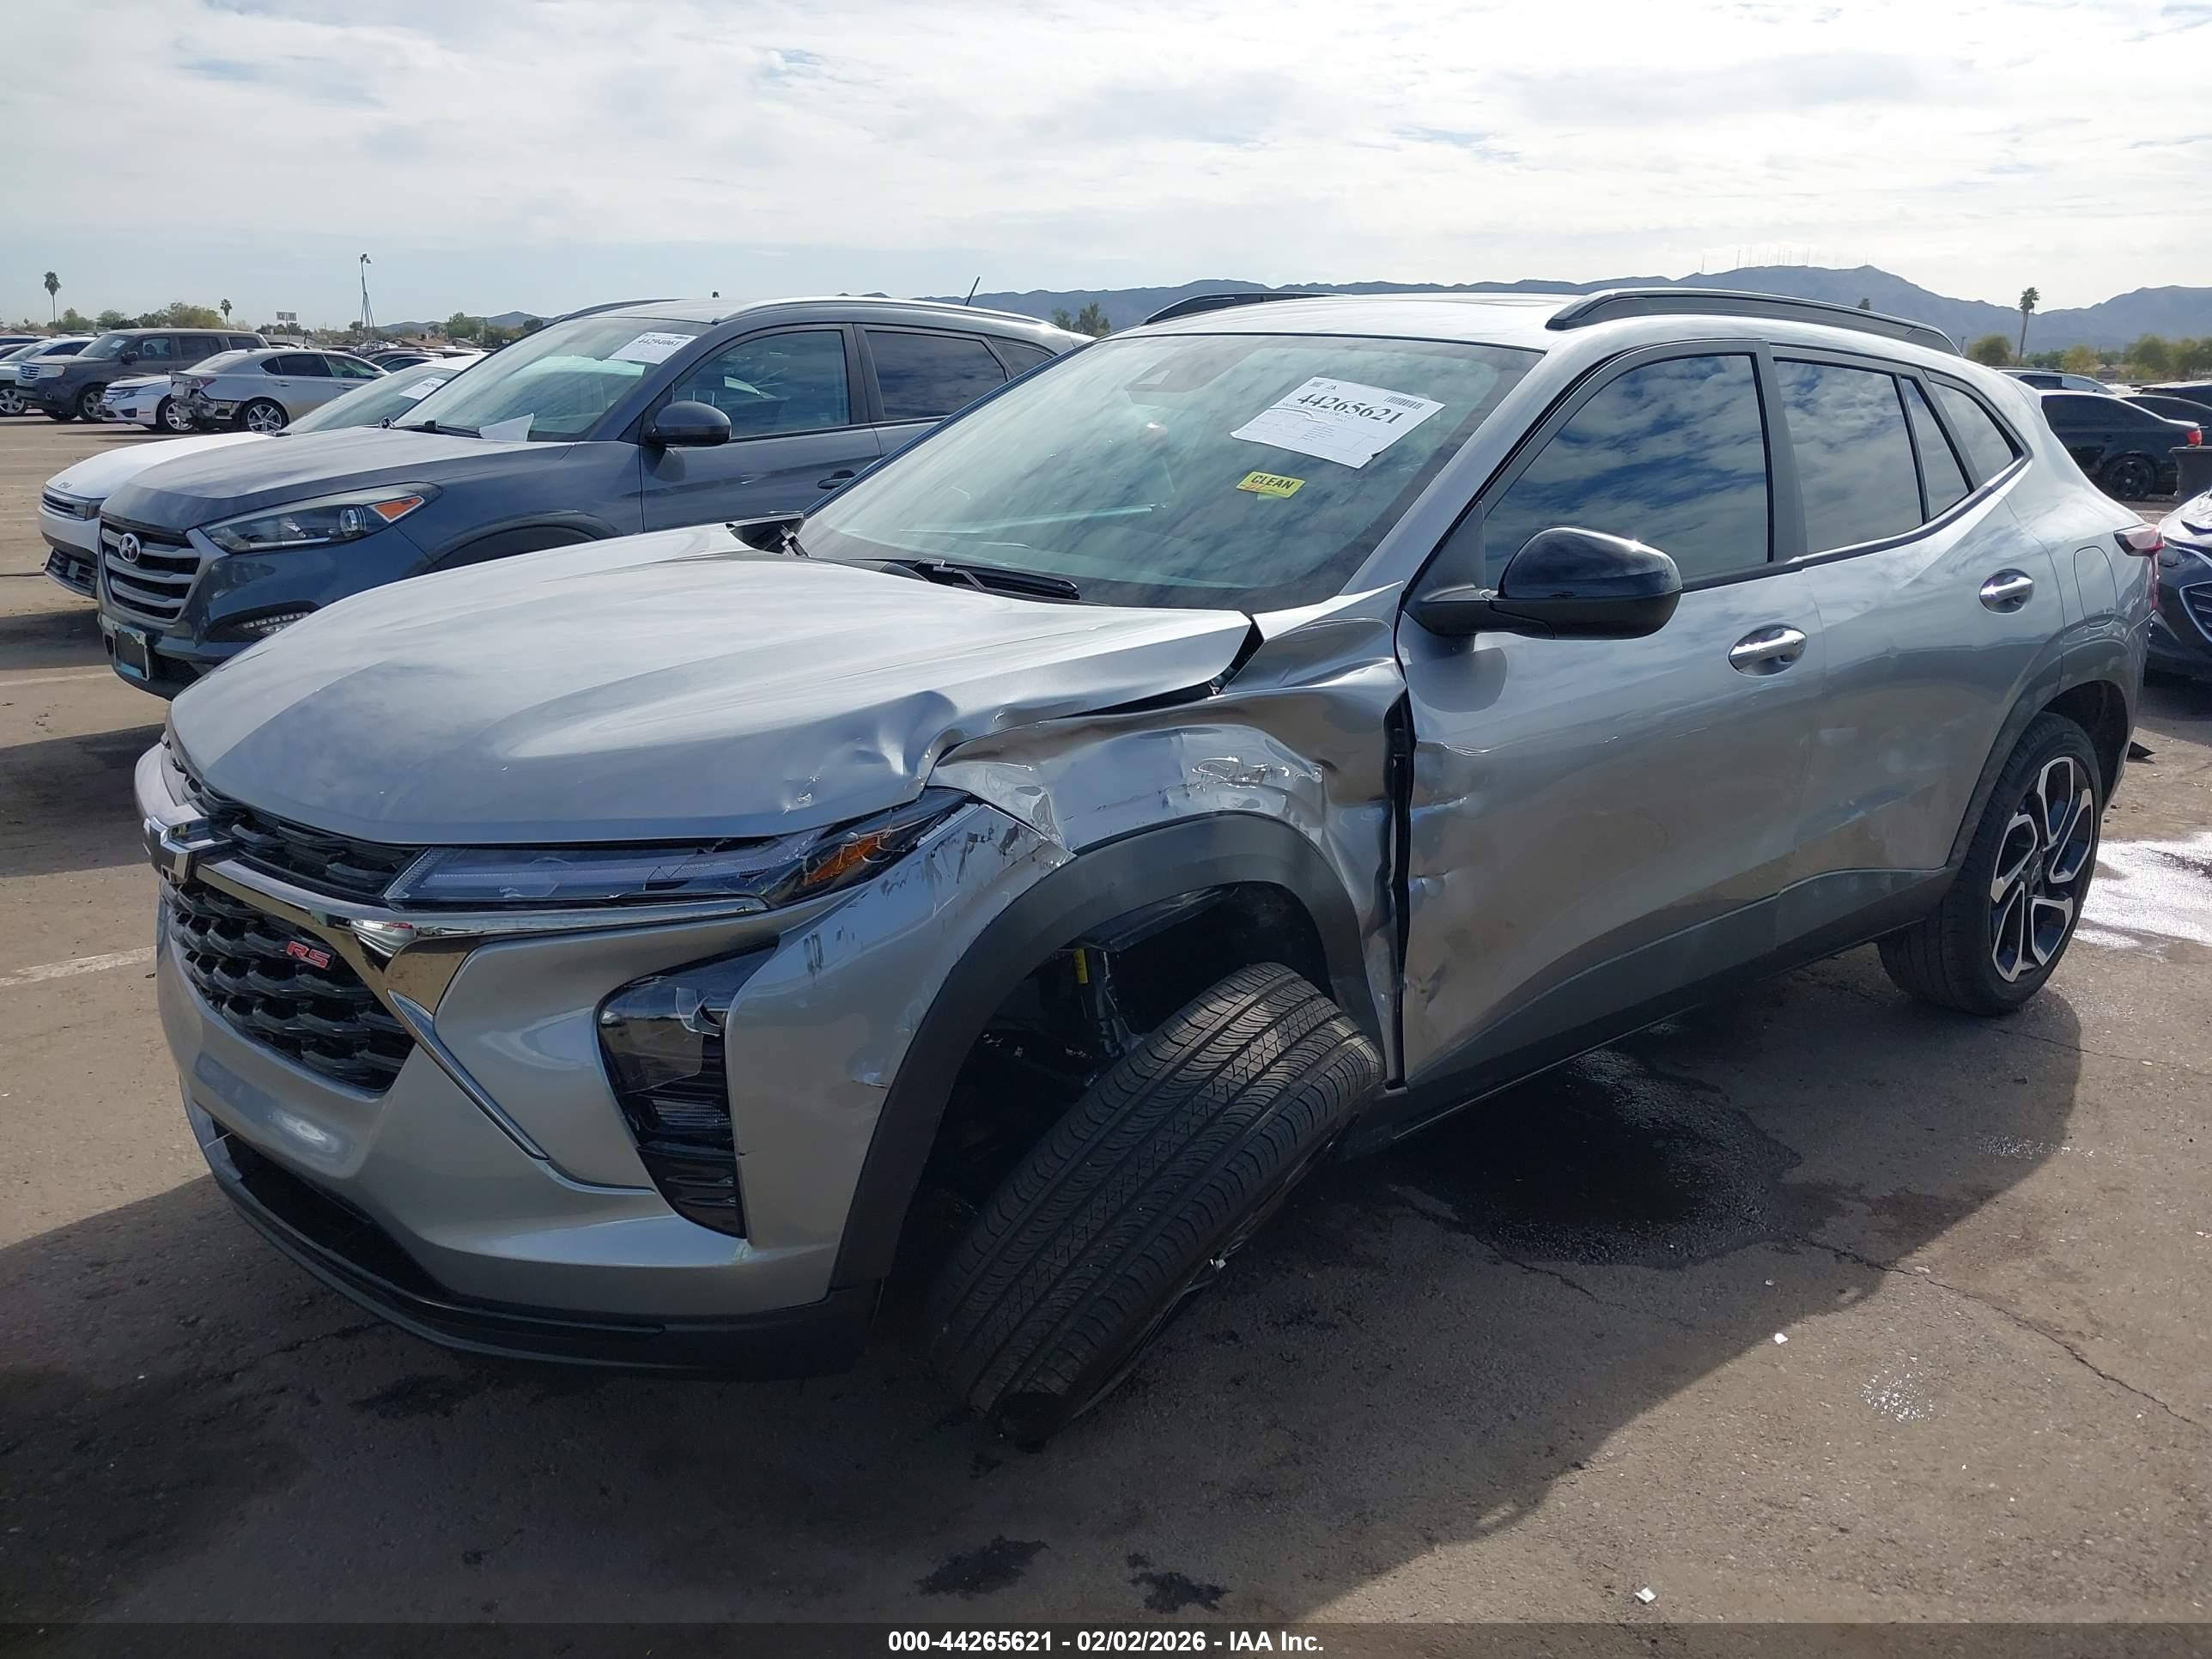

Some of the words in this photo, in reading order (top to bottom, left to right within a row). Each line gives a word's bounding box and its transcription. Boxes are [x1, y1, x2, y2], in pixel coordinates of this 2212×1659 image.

[1297, 393, 1404, 424] 44265621
[1250, 475, 1295, 489] CLEAN
[286, 940, 331, 969] RS
